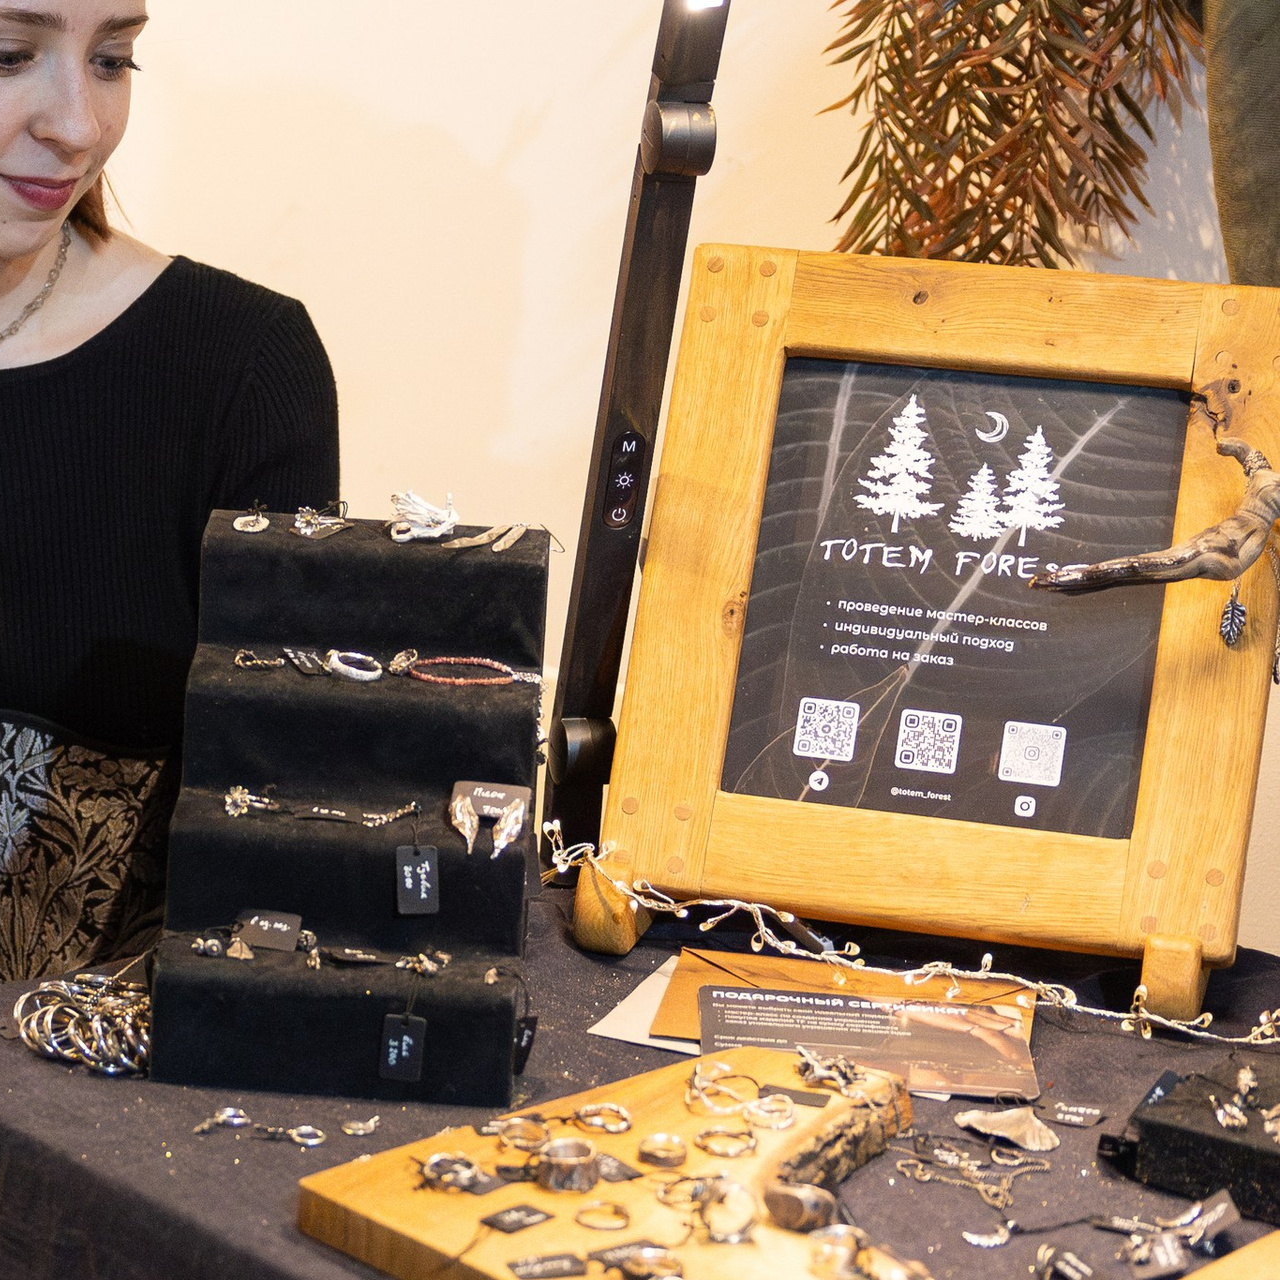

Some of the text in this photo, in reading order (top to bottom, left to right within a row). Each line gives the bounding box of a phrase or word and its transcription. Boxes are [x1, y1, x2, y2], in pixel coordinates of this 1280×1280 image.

[622, 440, 636, 452] M
[820, 538, 933, 575] TOTEM
[838, 599, 1048, 632] проведение мастер-классов
[834, 621, 1015, 652] индивидуальный подход
[830, 643, 954, 666] работа на заказ
[890, 786, 952, 802] @totem_forest
[712, 991, 969, 1016] ПОДАРОЧНЫЙ СЕРТИФИКАТ
